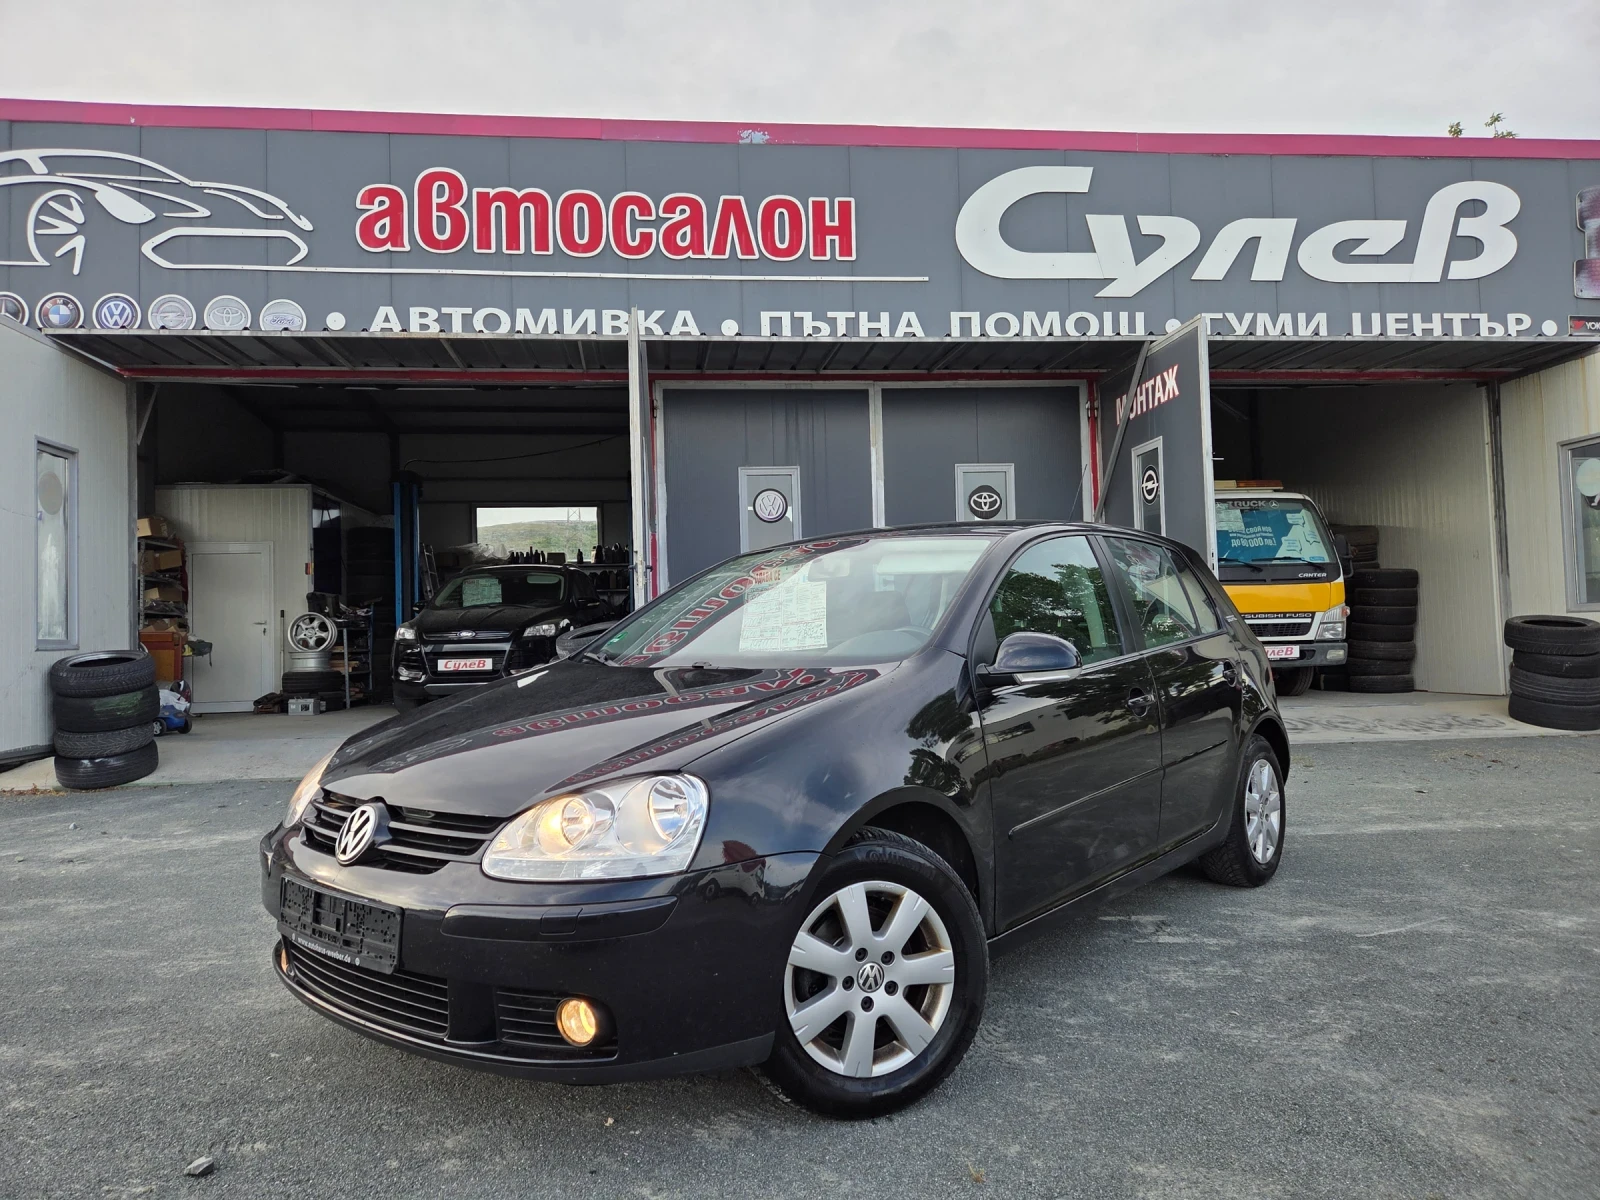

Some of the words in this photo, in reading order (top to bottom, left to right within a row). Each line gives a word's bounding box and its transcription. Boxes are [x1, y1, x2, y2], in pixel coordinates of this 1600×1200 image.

[356, 167, 856, 261] автосалон
[369, 305, 700, 336] АВТОМИВКА
[760, 310, 926, 337] ПЪТНА
[1201, 312, 1327, 337] ГУМИ
[1352, 312, 1532, 337] ЦЕНТЪР
